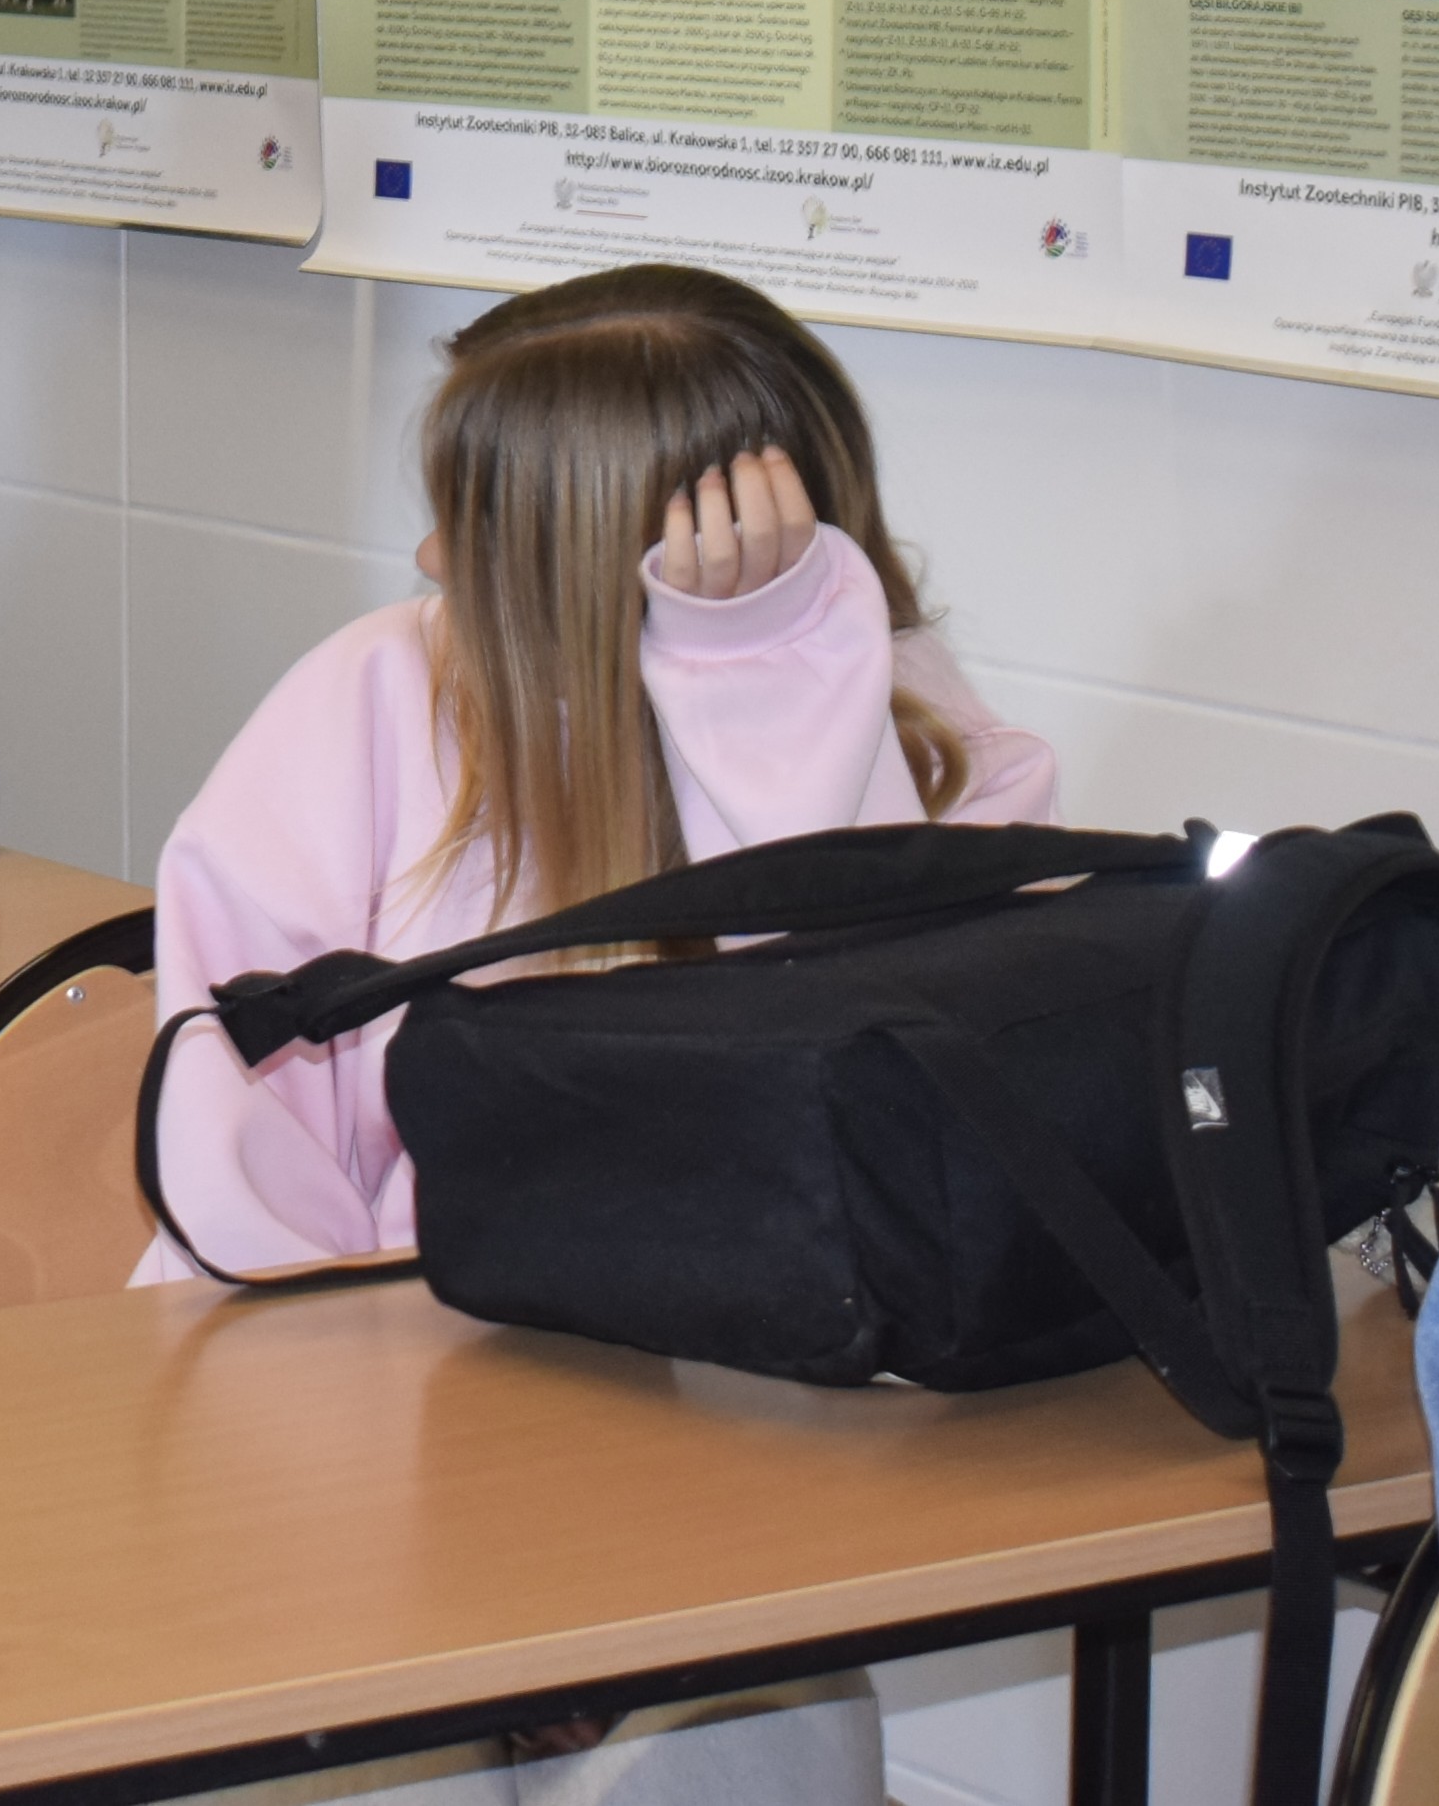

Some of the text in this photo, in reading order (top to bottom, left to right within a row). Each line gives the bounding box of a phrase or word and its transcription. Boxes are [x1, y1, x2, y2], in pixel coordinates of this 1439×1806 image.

[1238, 177, 1300, 204] Instytut
[1304, 183, 1394, 210] Zootechniki
[1398, 192, 1428, 217] PIB,
